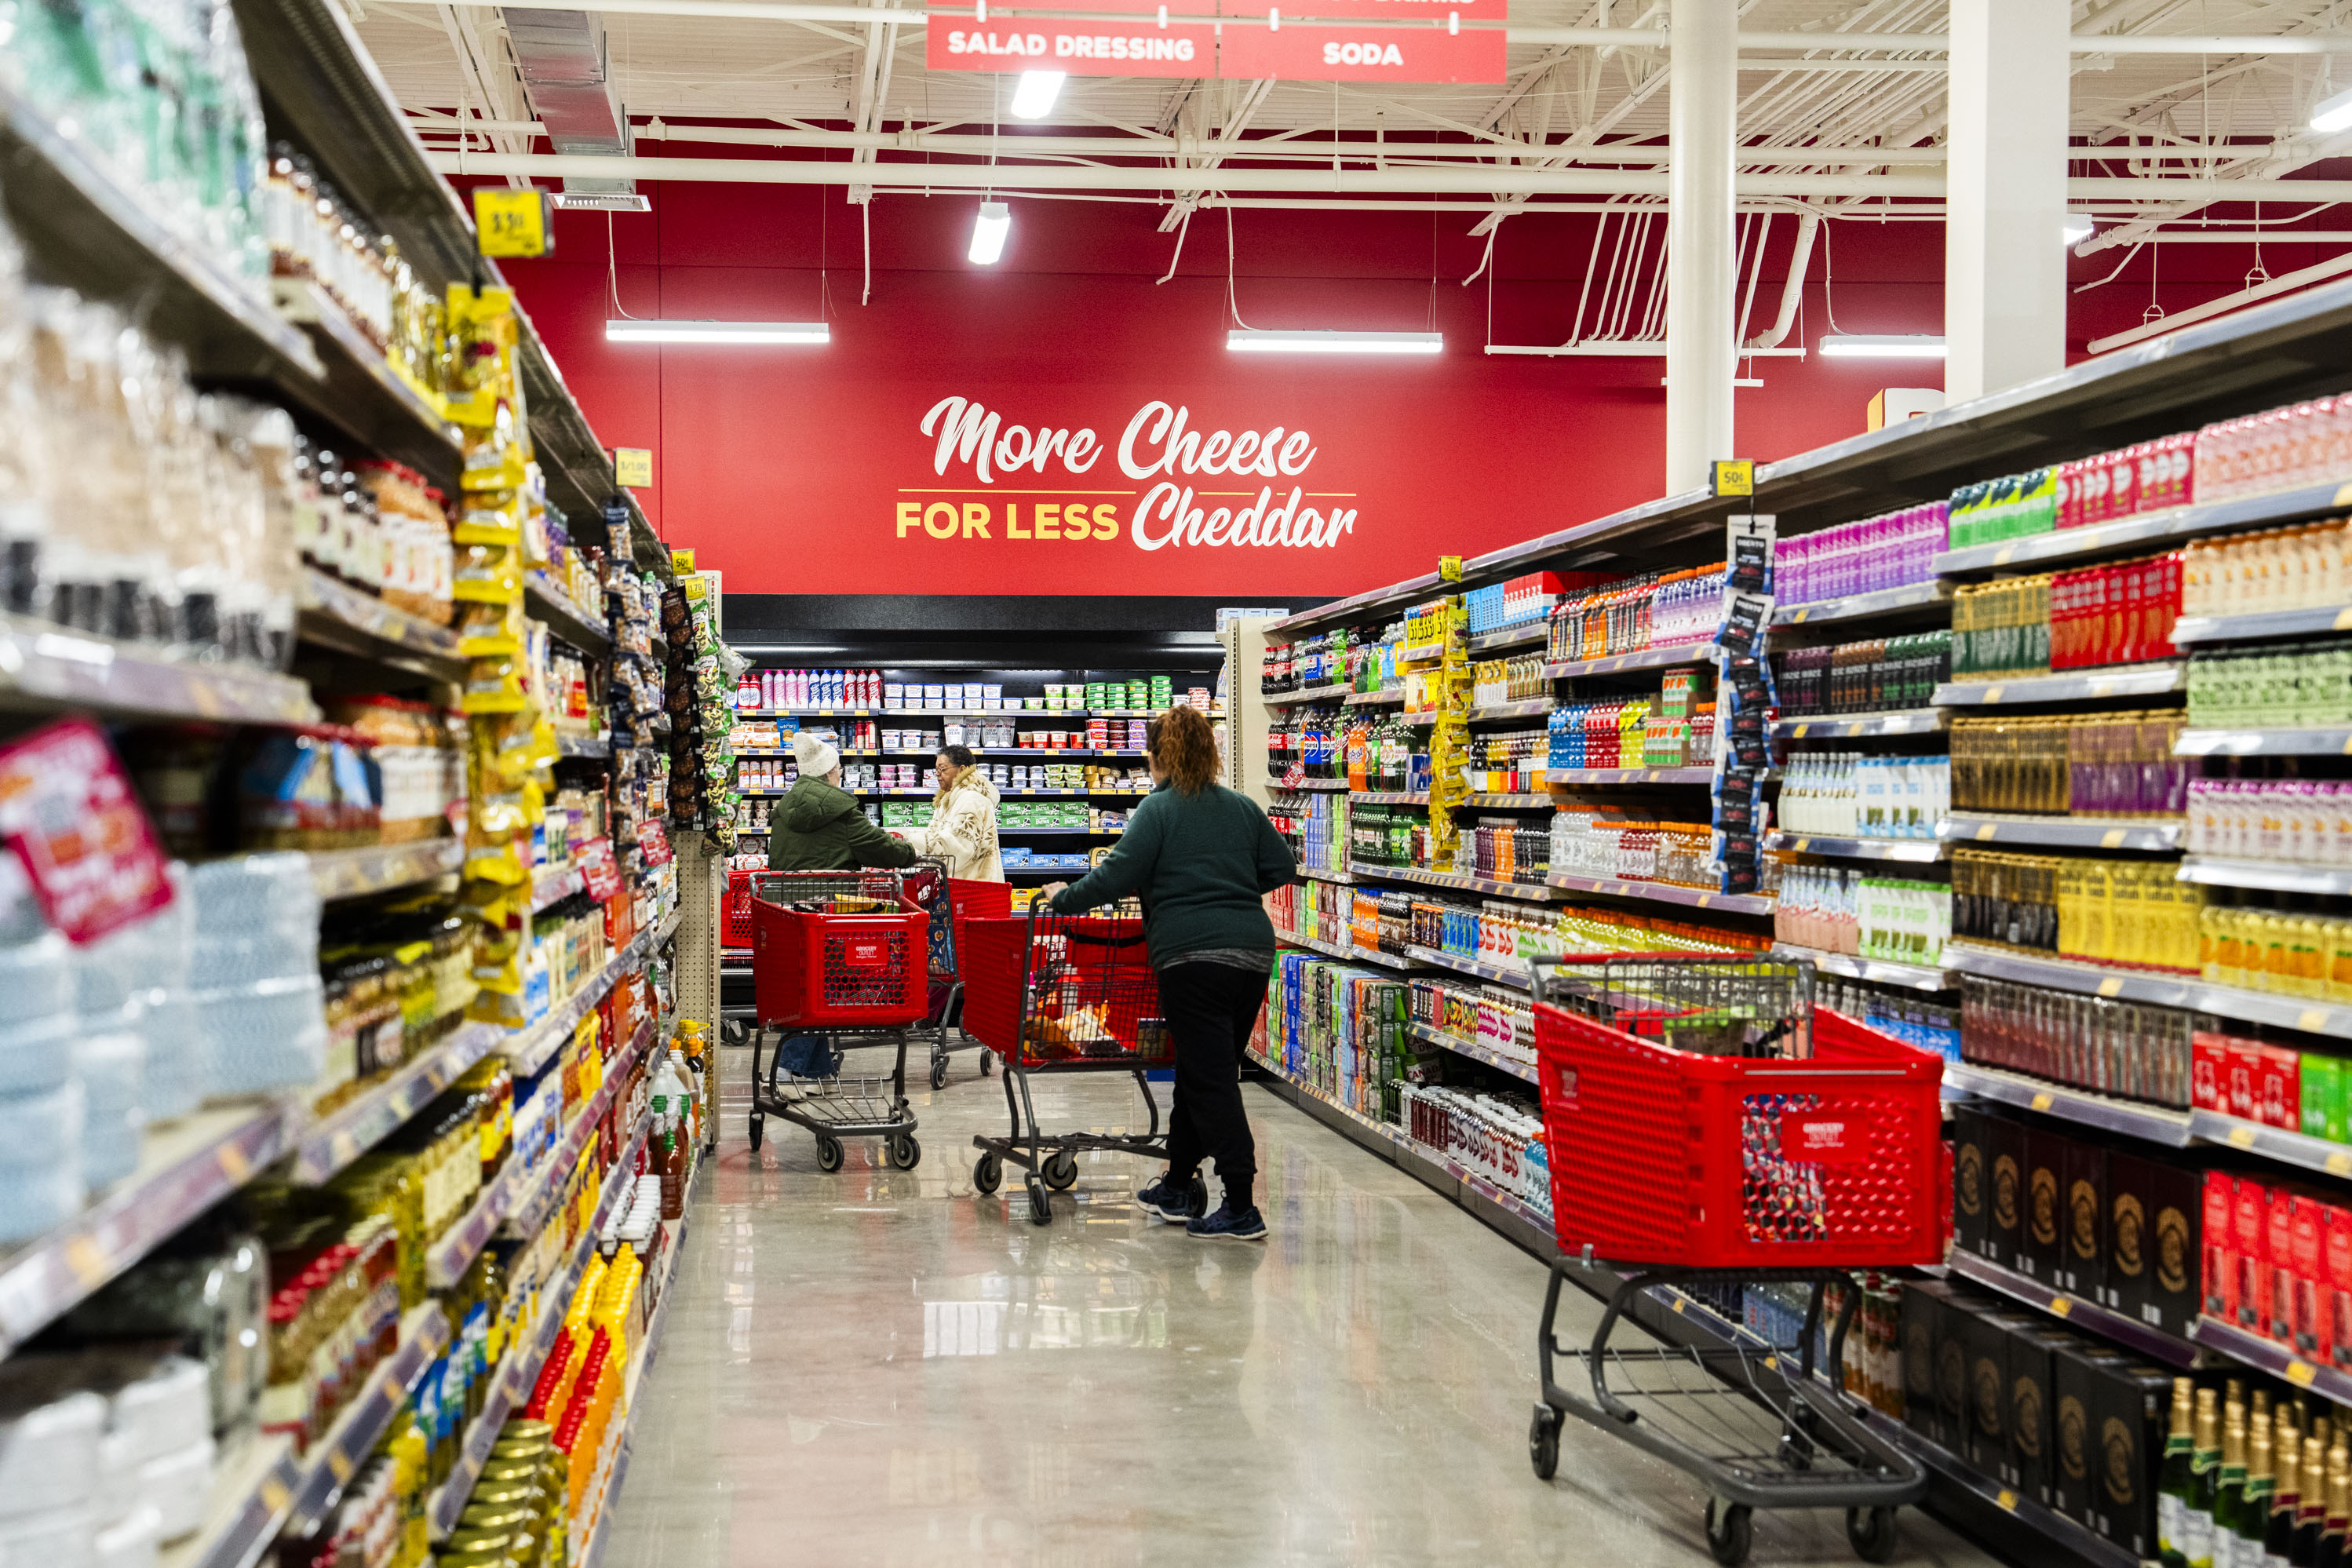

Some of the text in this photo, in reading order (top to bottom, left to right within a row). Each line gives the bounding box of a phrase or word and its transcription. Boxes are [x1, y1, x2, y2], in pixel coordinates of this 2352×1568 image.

[948, 31, 1194, 61] SALAD DRESSING
[1323, 42, 1403, 66] SODA
[920, 396, 1317, 483] More Cheese
[896, 482, 1358, 551] FOR LESS Cheddar
